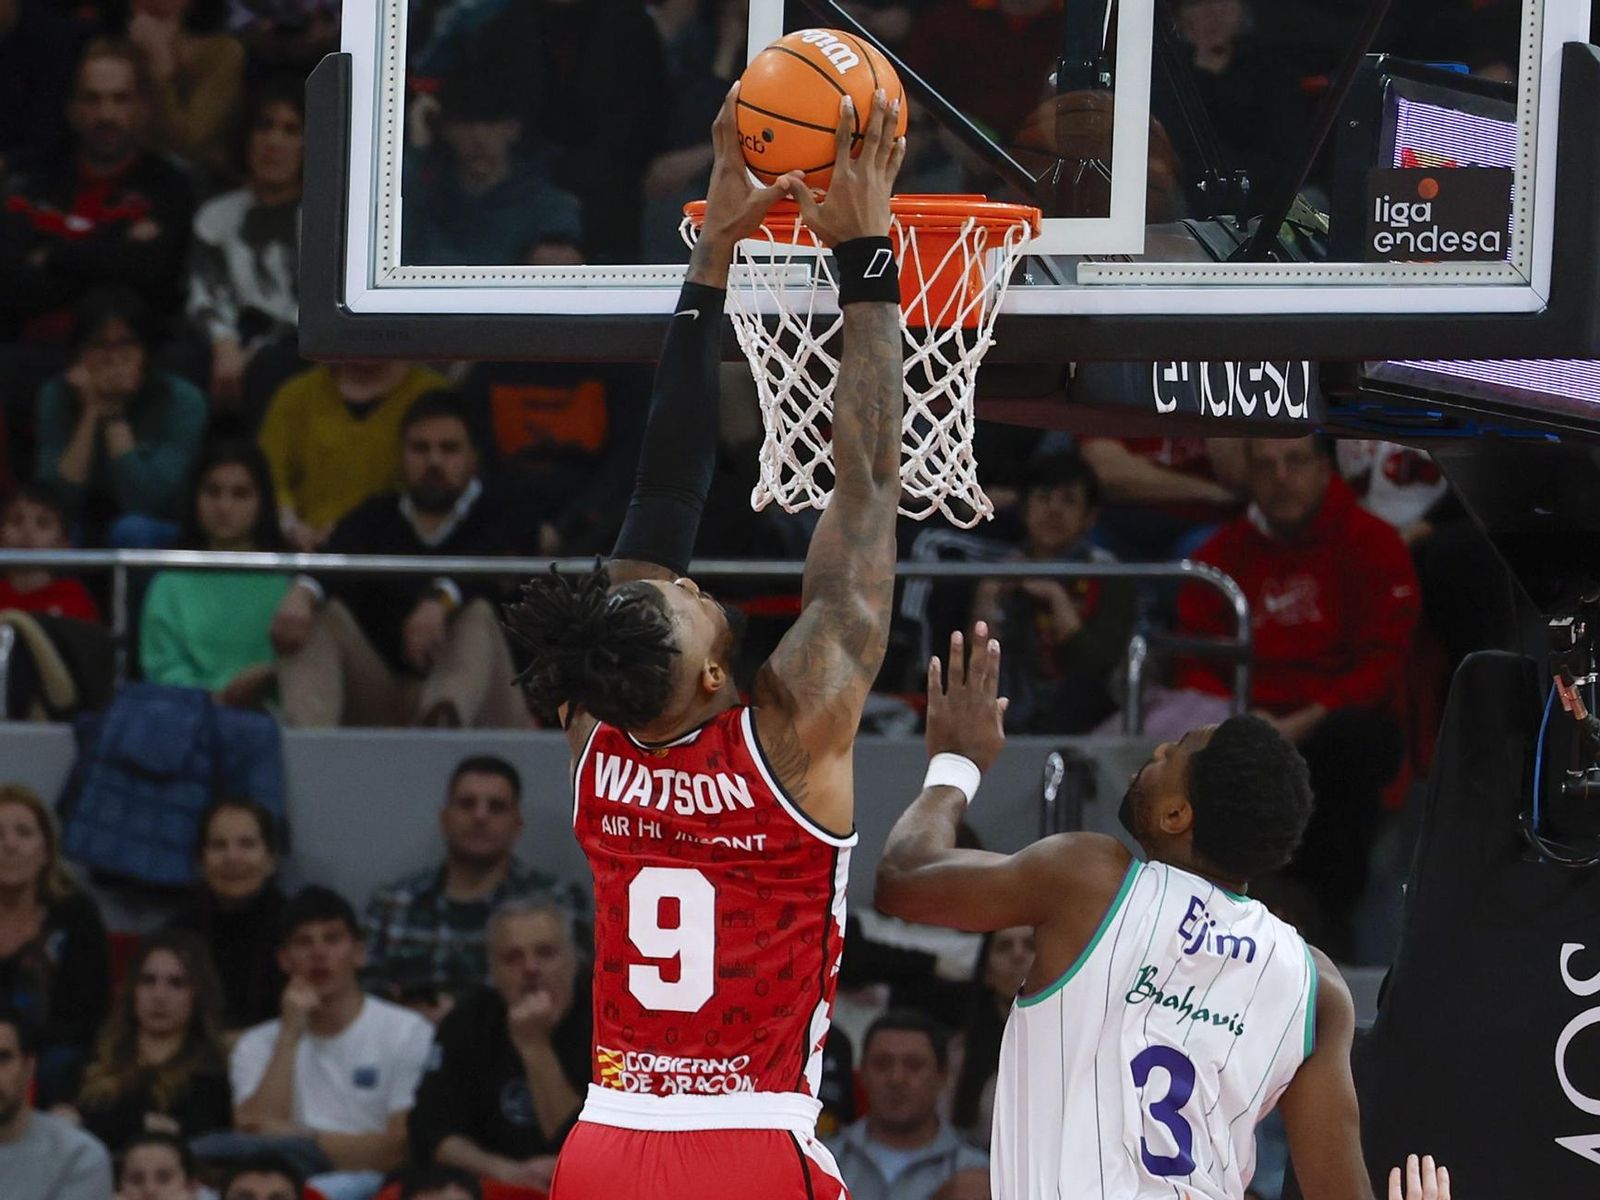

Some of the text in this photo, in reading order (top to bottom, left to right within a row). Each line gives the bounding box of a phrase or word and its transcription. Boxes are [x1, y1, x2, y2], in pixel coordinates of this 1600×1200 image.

[1375, 195, 1432, 227] liga
[1373, 225, 1500, 253] endesa
[595, 752, 755, 815] WATSON
[602, 815, 630, 836] AIR
[628, 867, 716, 1013] 9
[1178, 895, 1256, 963] Ejim
[620, 1072, 654, 1093] DE
[1130, 1045, 1197, 1176] 3
